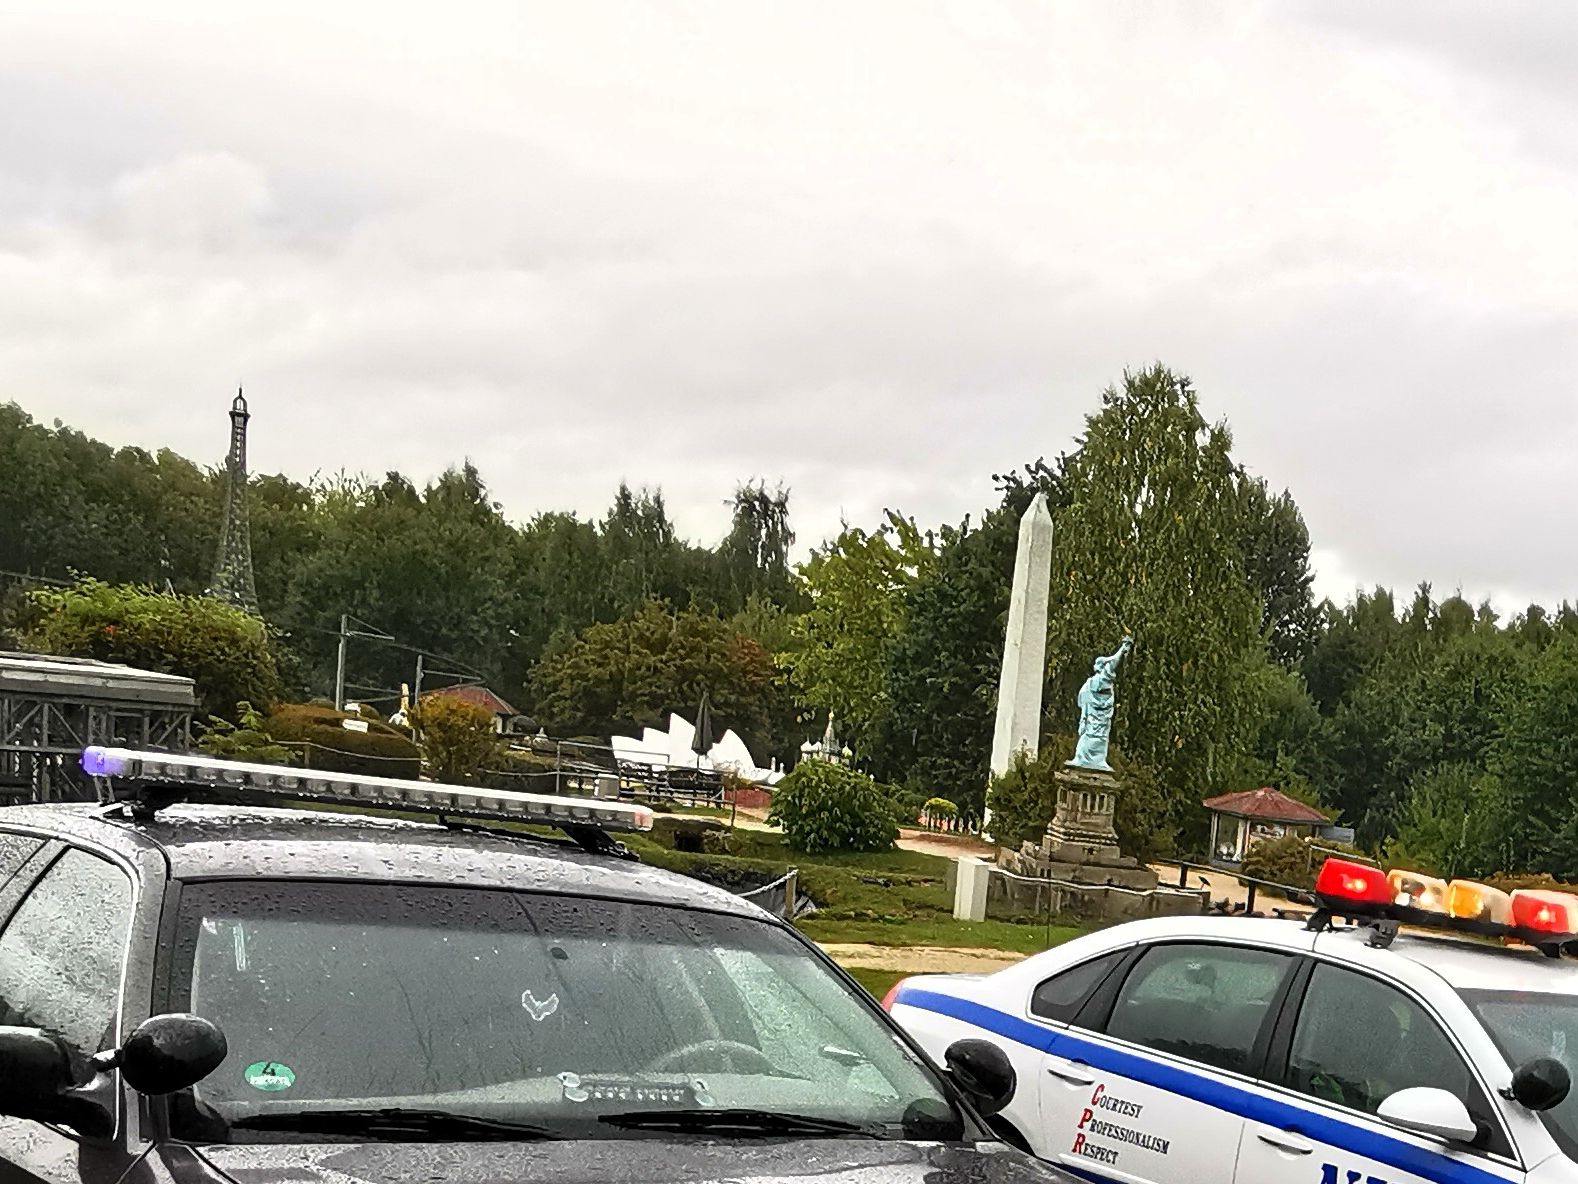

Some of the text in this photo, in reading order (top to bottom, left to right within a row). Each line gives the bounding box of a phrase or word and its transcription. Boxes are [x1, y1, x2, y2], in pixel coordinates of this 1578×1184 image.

[1091, 1084, 1143, 1118] COURTESY
[1077, 1108, 1170, 1154] PROFESSIONALISM
[1071, 1132, 1119, 1165] RESPECT
